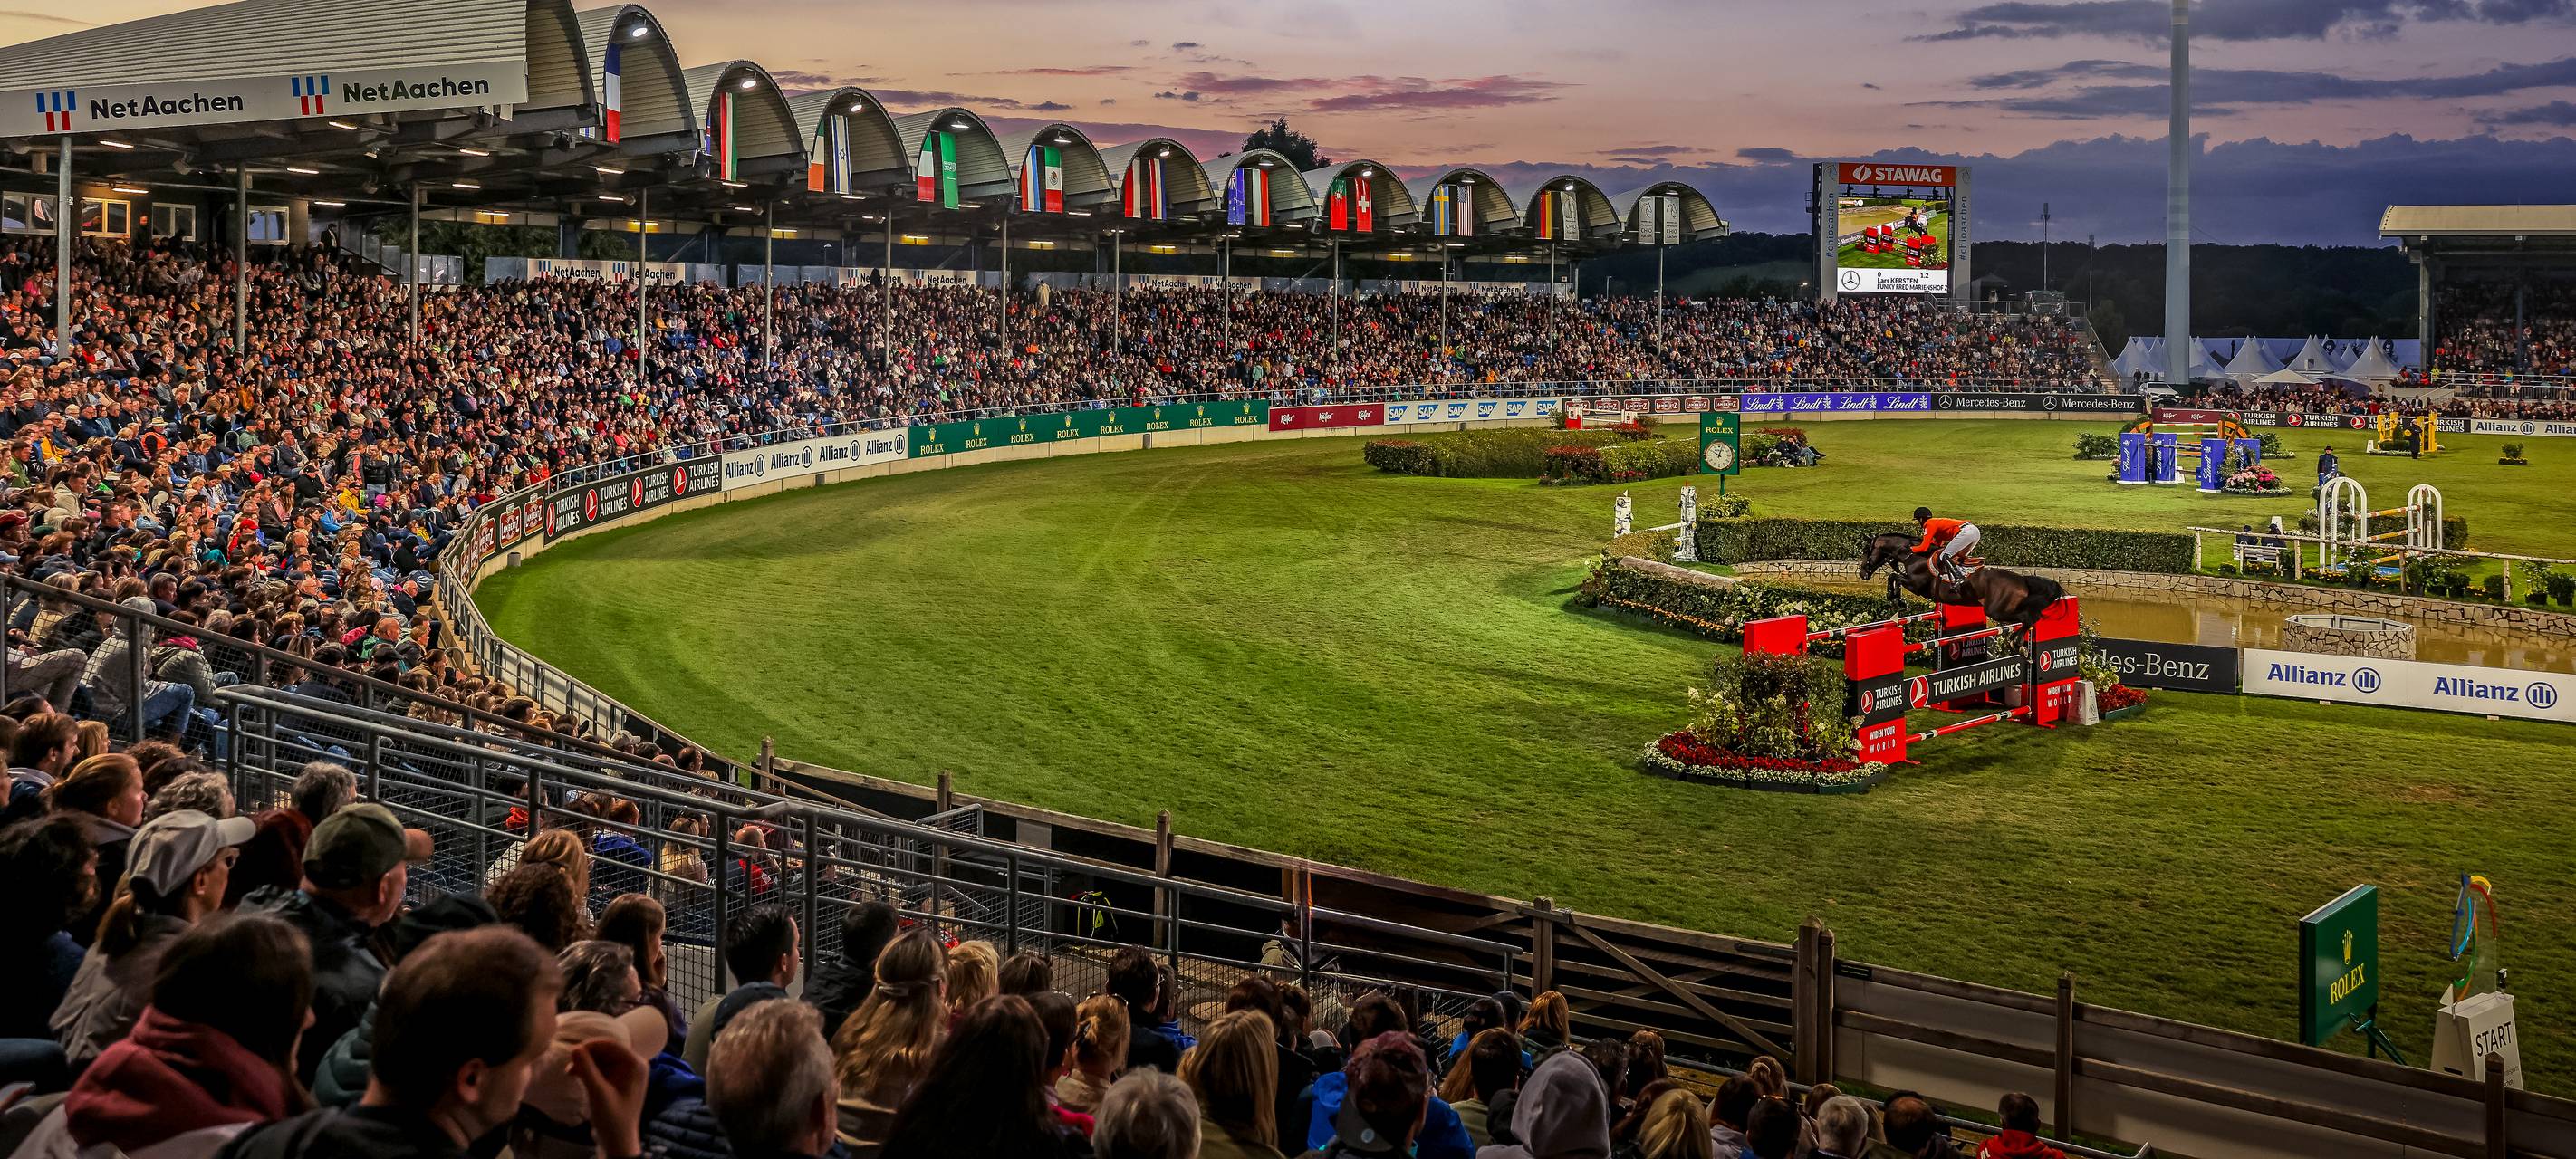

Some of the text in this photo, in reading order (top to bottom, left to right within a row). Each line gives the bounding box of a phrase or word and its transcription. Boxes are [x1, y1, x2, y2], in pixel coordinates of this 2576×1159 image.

[343, 76, 490, 103] NetAachen
[91, 93, 244, 120] NetAachen
[1875, 167, 1942, 183] STAWAG
[1826, 193, 1834, 258] #chioaachen
[1958, 196, 1966, 260] #chioaachen
[554, 266, 601, 278] NetAachen
[630, 268, 675, 280] NeAachen
[1537, 404, 1552, 412] SAP
[1745, 397, 1777, 411] Lindt
[1790, 397, 1822, 410] Lindt
[1837, 396, 1869, 410] Lindt
[1883, 396, 1916, 410] Lindt
[1956, 397, 2026, 407] Mercedes-Benz
[2062, 398, 2135, 409] Mercedes-Benz
[1389, 408, 1404, 419] SAP
[1418, 407, 1434, 417] SAP
[1449, 407, 1464, 416] SAP
[1478, 406, 1494, 415] SAP
[1507, 405, 1523, 414] SAP
[1146, 421, 1168, 431] ROLEX
[1189, 418, 1212, 427] ROLEX
[1235, 416, 1257, 424] ROLEX
[2476, 422, 2517, 432] Allianz
[1057, 428, 1079, 439] ROLEX
[1101, 425, 1123, 434] ROLEX
[966, 438, 987, 448] ROLEX
[1011, 433, 1034, 444] ROLEX
[820, 446, 848, 462] Allianz
[866, 440, 892, 455] Allianz
[920, 443, 944, 455] ROLEX
[771, 453, 800, 470] Allianz
[689, 461, 719, 477] TURKISH
[725, 462, 754, 479] Allianz
[2203, 455, 2212, 483] Lindt
[645, 470, 669, 485] TURKISH
[688, 475, 719, 492] AIRLINES
[601, 481, 628, 501] TURKISH
[645, 485, 669, 503] AIRLINES
[556, 494, 580, 511] TURKISH
[600, 497, 628, 517] AIRLINES
[555, 511, 580, 532] AIRLINES
[2052, 647, 2077, 658] TURKISH
[2052, 656, 2078, 669] AIRLINES
[1933, 663, 2021, 696] TURKISH AIRLINES
[2267, 663, 2346, 686] Allianz
[1875, 684, 1902, 699] TURKISH
[2433, 676, 2519, 702] Allianz
[1875, 697, 1902, 711] AIRLINES
[1870, 726, 1895, 741] WIDEN YOUR
[2330, 963, 2365, 1005] ROLEX
[2475, 1021, 2512, 1057] START
